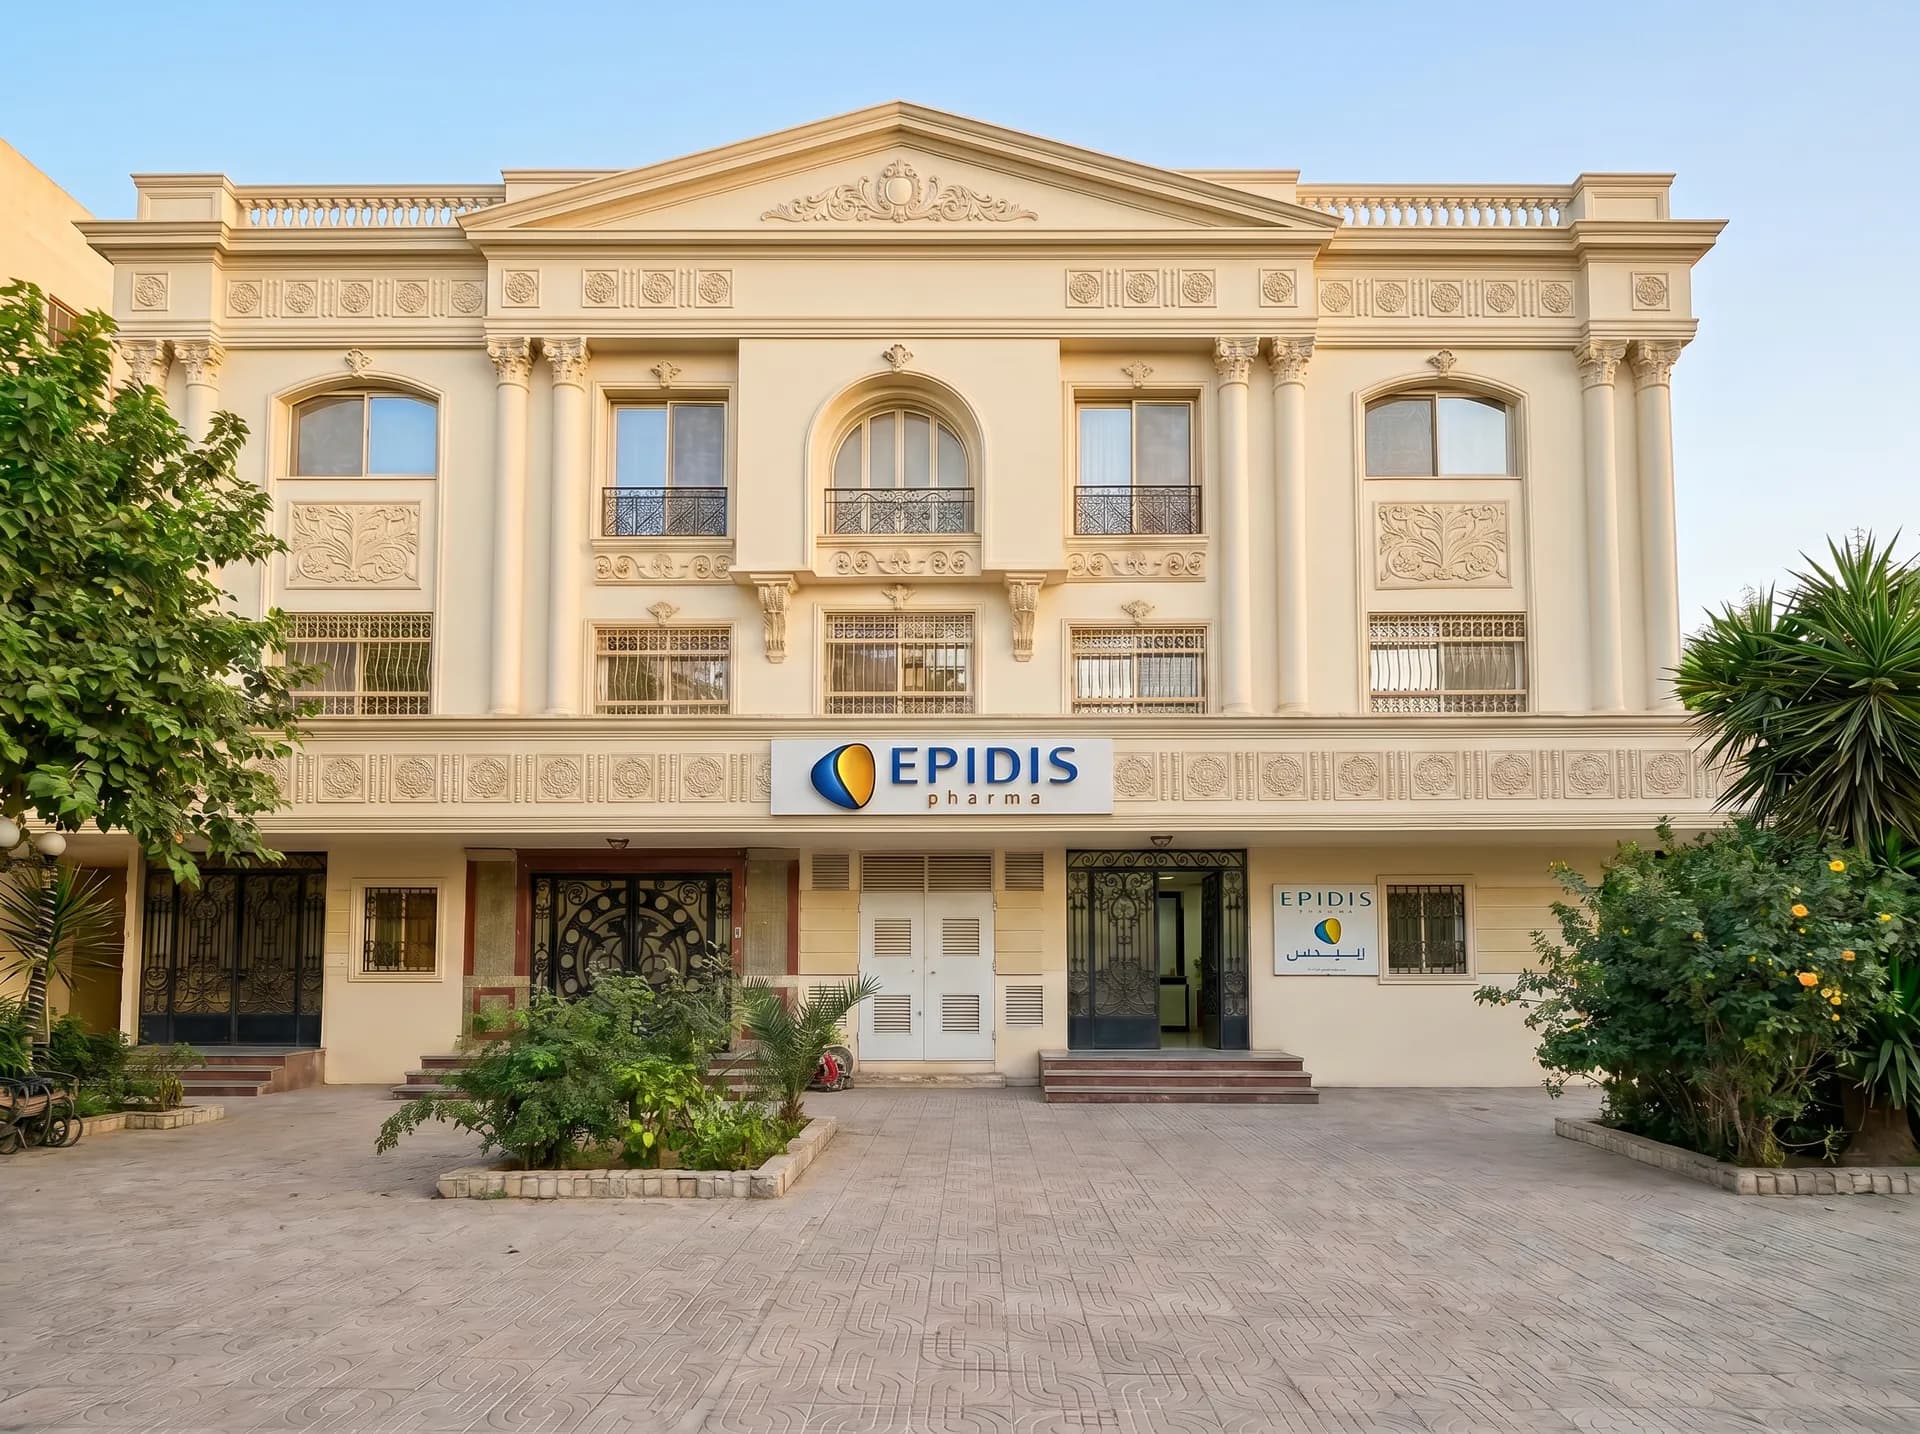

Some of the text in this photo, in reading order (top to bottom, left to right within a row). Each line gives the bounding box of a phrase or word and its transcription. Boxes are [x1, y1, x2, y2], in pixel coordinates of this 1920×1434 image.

[891, 746, 1079, 785] EPIDIS
[928, 790, 1041, 809] pharma
[1281, 891, 1372, 907] EPIDIS
